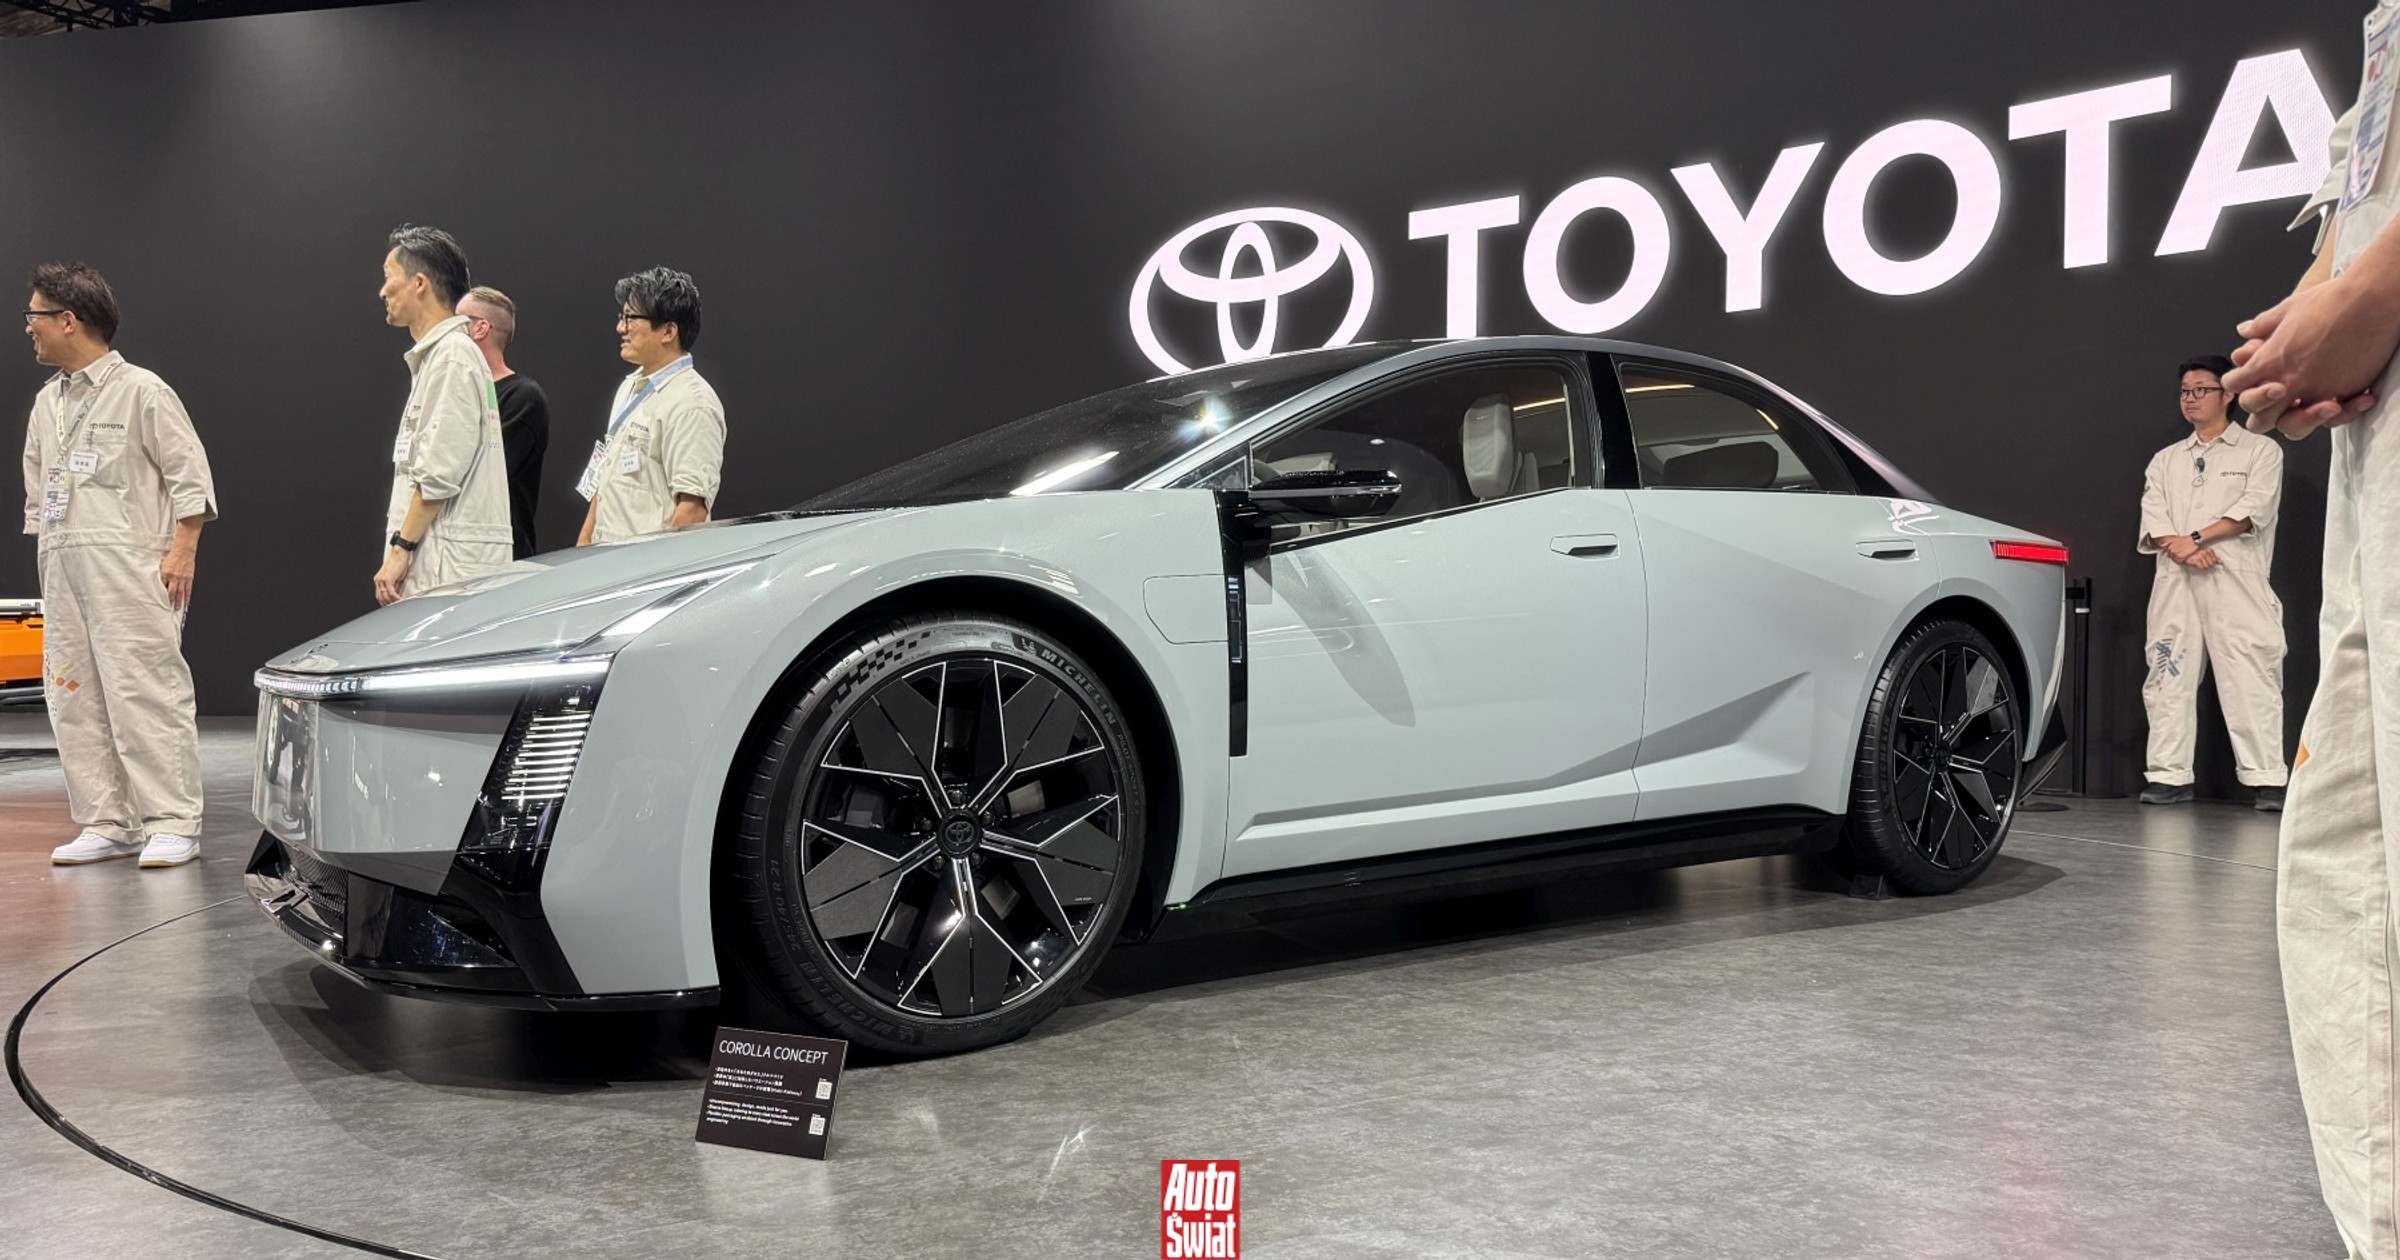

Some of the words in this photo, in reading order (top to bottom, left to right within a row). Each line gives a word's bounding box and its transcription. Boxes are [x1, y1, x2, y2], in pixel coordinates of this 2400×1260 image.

[1408, 49, 2338, 338] TOYOTA
[98, 422, 126, 430] TOYOTA
[1041, 649, 1117, 725] MICHELIN
[769, 859, 780, 877] 21
[799, 961, 896, 1034] MICHELIN
[719, 1040, 771, 1059] COROLLA
[773, 1046, 829, 1065] CONCEPT
